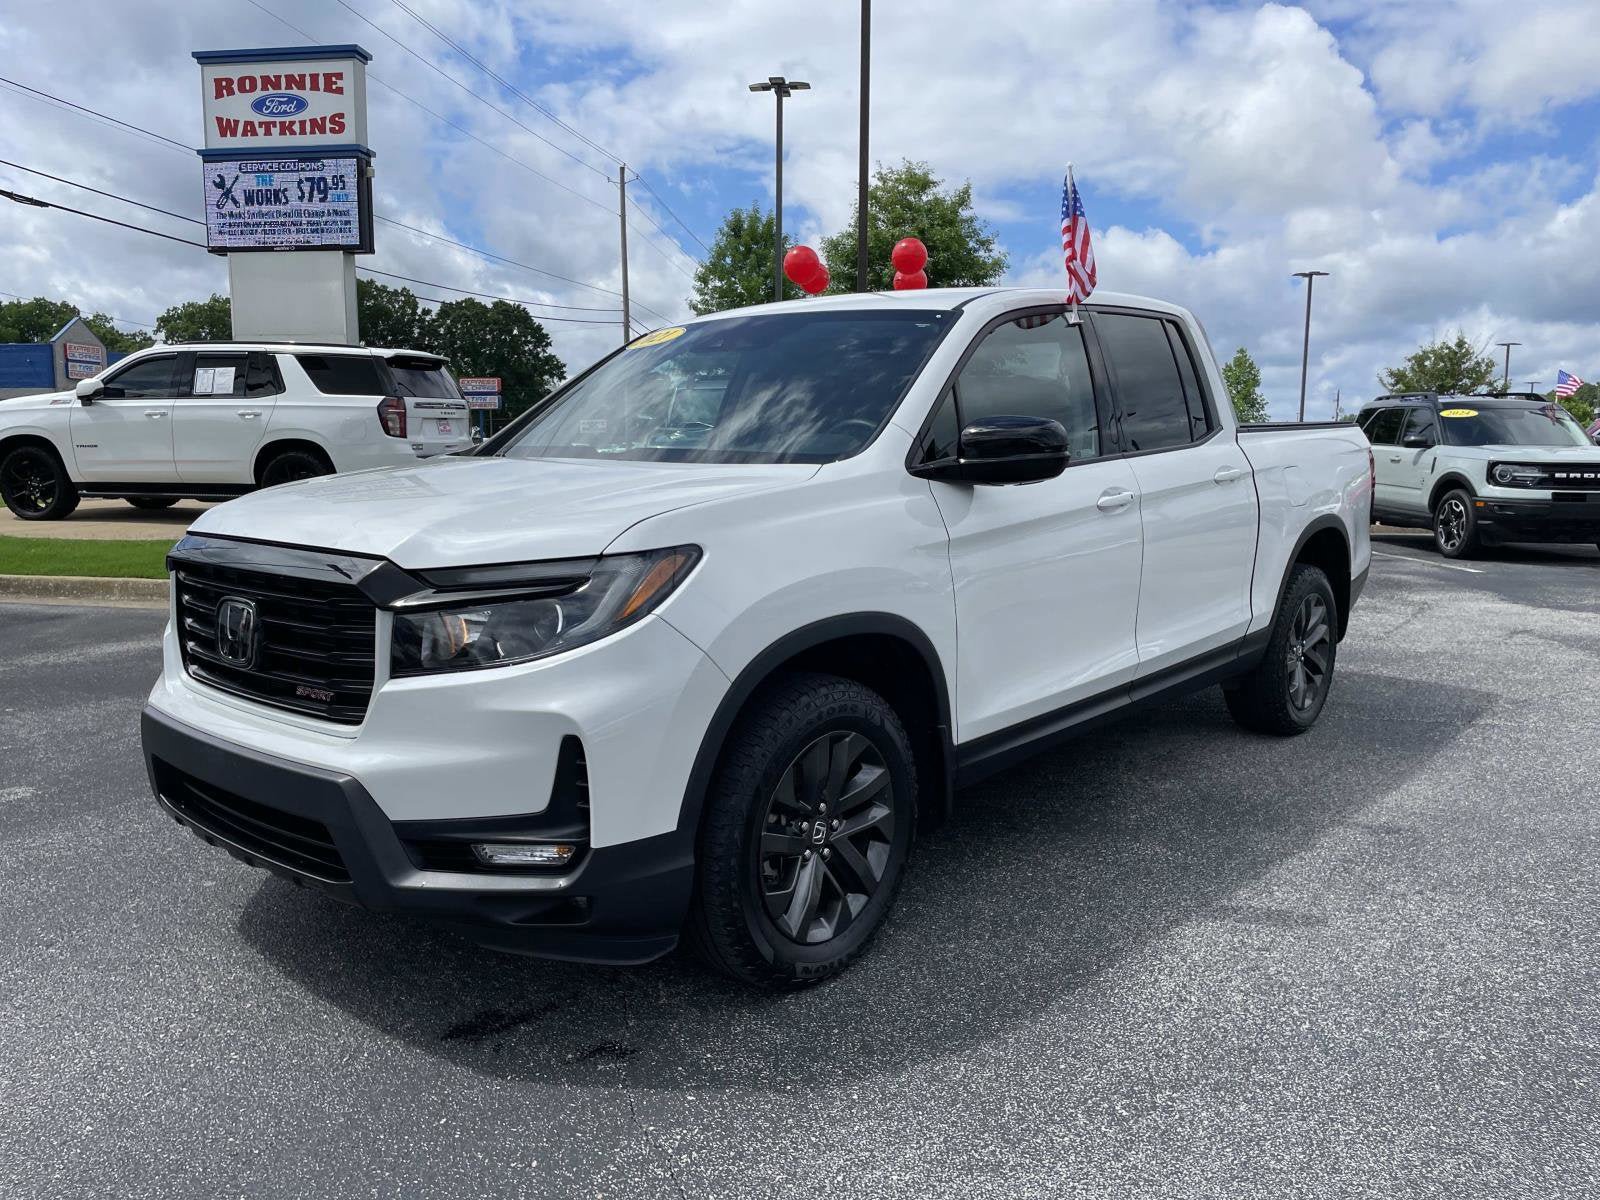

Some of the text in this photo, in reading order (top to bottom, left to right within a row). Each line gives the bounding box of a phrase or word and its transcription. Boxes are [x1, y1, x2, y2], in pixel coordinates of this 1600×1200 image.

[213, 72, 344, 100] RONNIE
[262, 97, 297, 114] Ford
[215, 112, 346, 138] WATKINS
[240, 160, 324, 172] SERVICE COUPONS
[255, 173, 275, 187] THE
[243, 187, 289, 206] WORKS
[68, 344, 101, 355] EXPRESS
[79, 353, 101, 361] CHANGE
[79, 364, 94, 372] TIRE
[295, 685, 335, 702] SPORT
